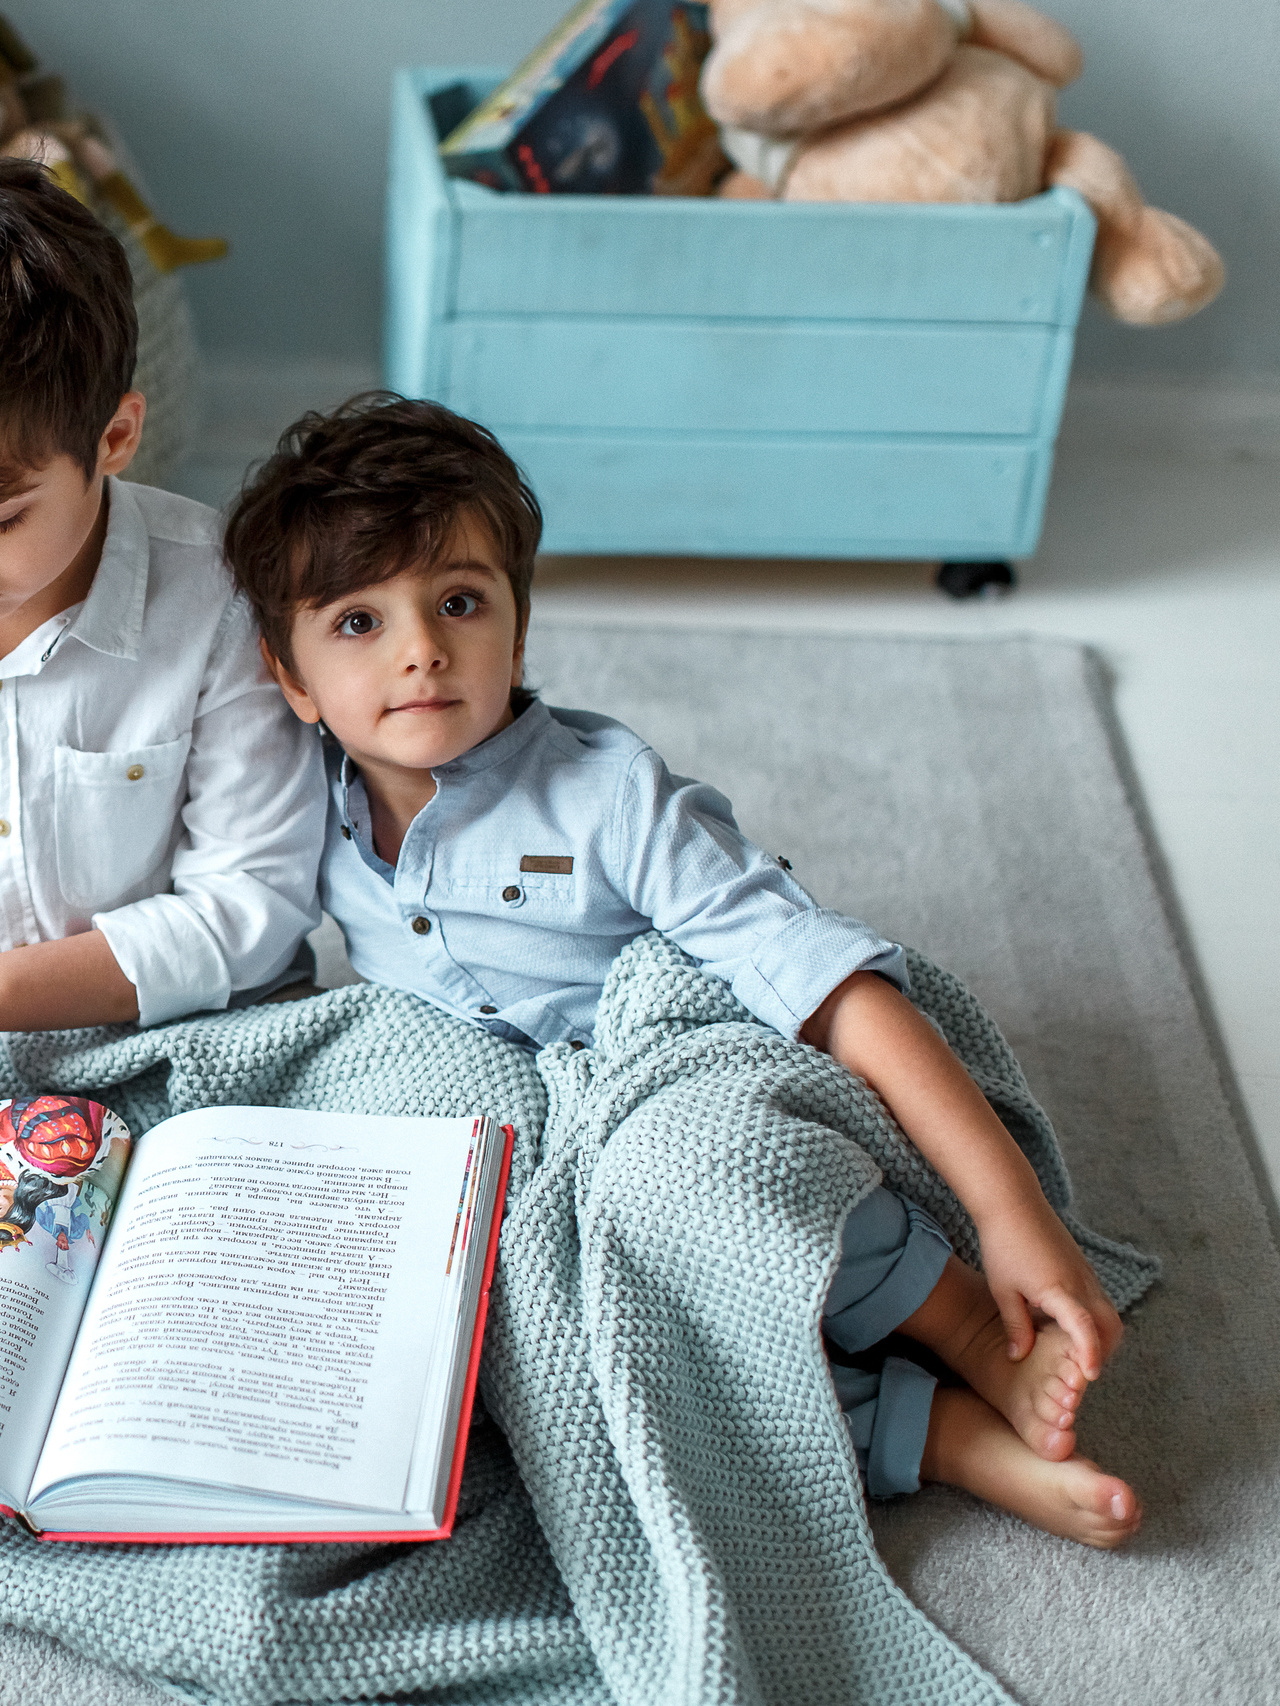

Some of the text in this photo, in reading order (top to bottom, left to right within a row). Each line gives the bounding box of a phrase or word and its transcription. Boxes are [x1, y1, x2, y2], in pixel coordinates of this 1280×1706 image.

[256, 1164, 284, 1172] лежат
[283, 1160, 314, 1168] принес
[317, 1163, 355, 1173] которые
[287, 1168, 314, 1176] сумке
[316, 1171, 357, 1180] кожаной
[262, 1186, 292, 1196] голову
[376, 1184, 408, 1193] повара
[247, 1192, 280, 1202] повара
[295, 1191, 339, 1201] звериную
[309, 1201, 349, 1210] скажете
[342, 1196, 404, 1208] когда-нибудь
[221, 1214, 267, 1223] принесли
[274, 1220, 327, 1231] принцессы
[287, 1229, 341, 1240] отрезанные
[334, 1227, 389, 1240] Горничные
[217, 1236, 257, 1246] которых
[343, 1236, 383, 1245] кармана
[220, 1252, 275, 1264] осмелились
[302, 1255, 342, 1264] дырявое
[331, 1250, 363, 1259] платья
[292, 1261, 323, 1270] жизни
[344, 1258, 366, 1267] двор
[177, 1273, 237, 1283] королевской
[349, 1267, 390, 1280] Никогда
[261, 1281, 287, 1290] шить
[1, 1286, 38, 1306] Вскочил
[243, 1287, 289, 1298] портнихи
[323, 1290, 385, 1302] приходилось
[302, 1295, 342, 1305] портные
[10, 1297, 44, 1316] зеленая
[346, 1300, 374, 1311] Когда
[1, 1303, 33, 1322] Только
[17, 1317, 39, 1332] вили
[9, 1332, 33, 1348] ными
[4, 1358, 25, 1372] семи
